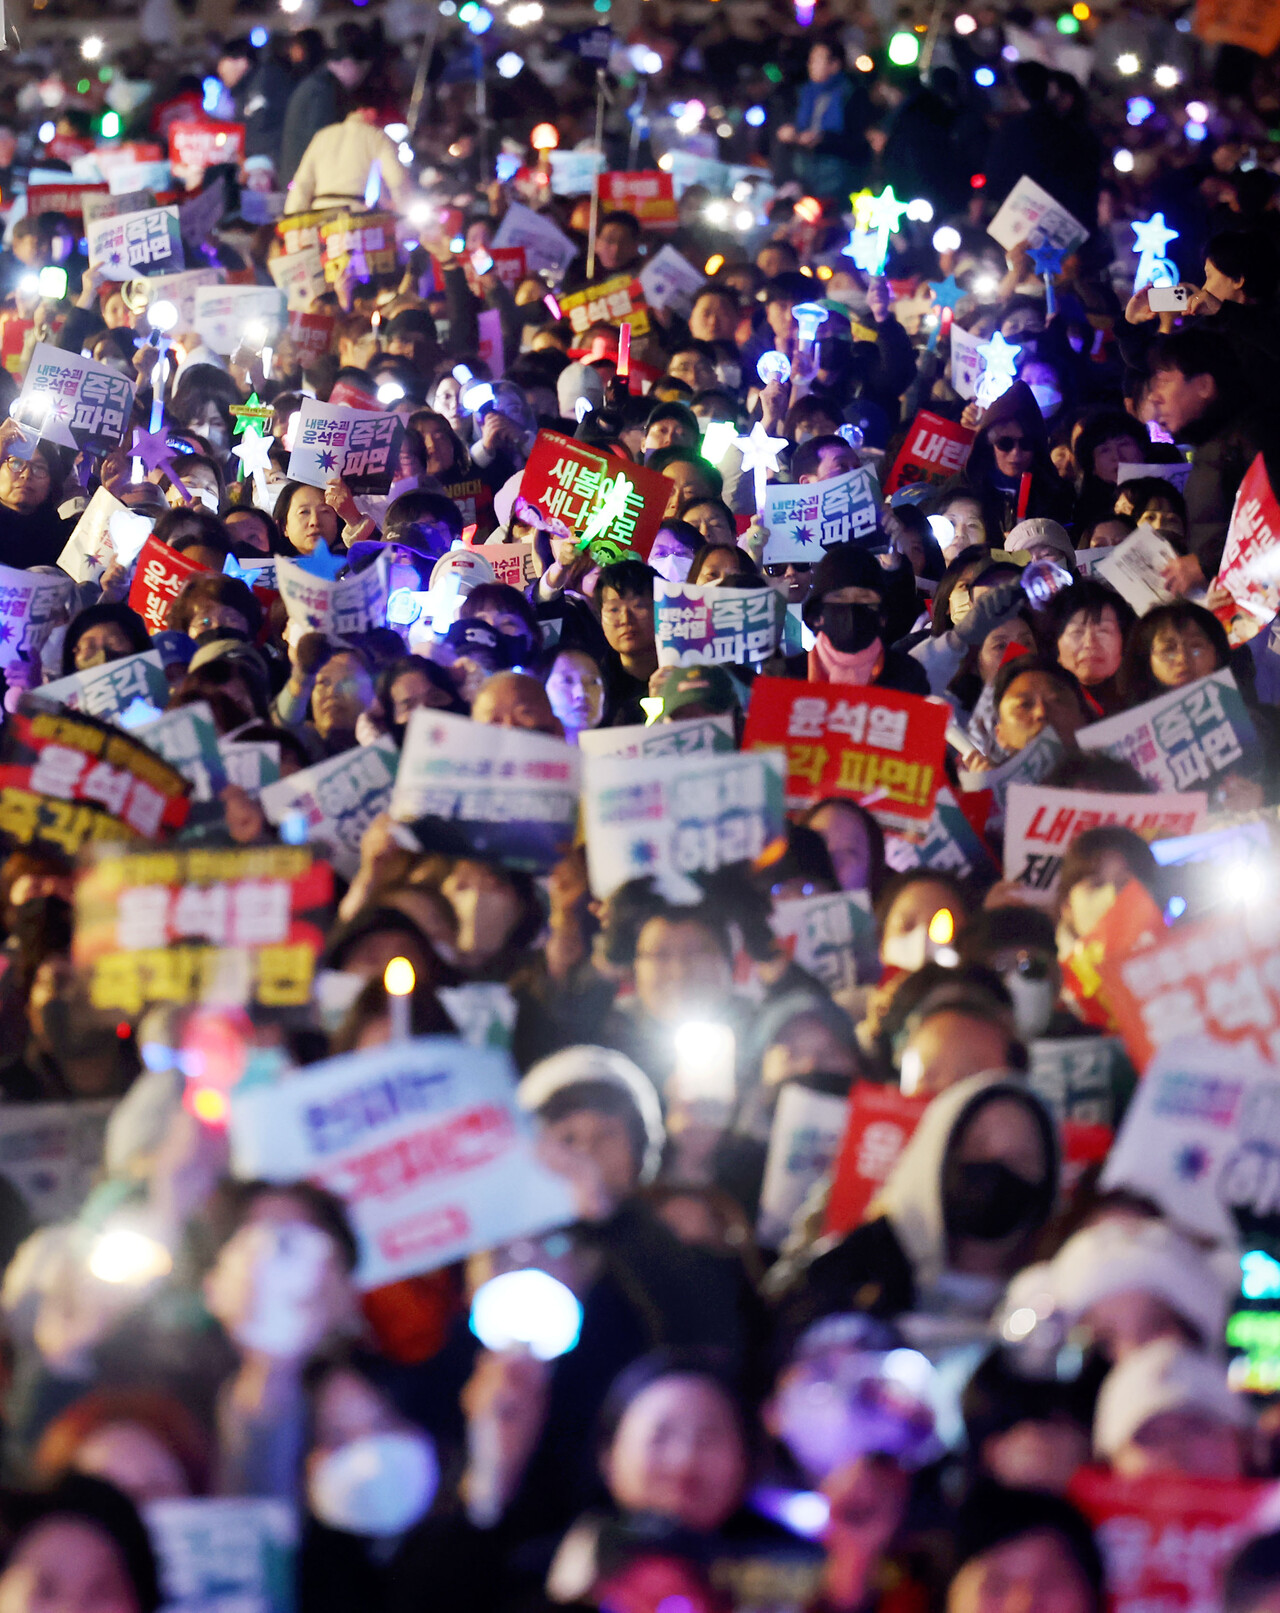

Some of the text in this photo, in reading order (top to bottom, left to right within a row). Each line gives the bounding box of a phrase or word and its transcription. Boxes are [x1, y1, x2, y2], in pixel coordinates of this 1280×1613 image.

[127, 211, 168, 243] 즉각
[128, 234, 172, 266] 파면
[32, 376, 79, 397] 윤석열
[37, 363, 83, 380] 내란수괴
[81, 371, 130, 409] 즉각
[71, 403, 124, 438] 파면
[304, 417, 350, 432] 내란수괴
[350, 416, 399, 448] 즉각
[302, 429, 347, 447] 윤석열
[342, 446, 390, 477] 파면
[771, 494, 819, 511] 내란수괴
[823, 469, 873, 517] 즉각
[772, 506, 819, 525] 윤석열
[821, 506, 877, 545] 파면
[143, 559, 190, 598] 윤석
[491, 556, 520, 571] 란수괴
[712, 592, 776, 630] 즉각
[658, 620, 707, 641] 윤석열
[712, 626, 776, 665] 파면
[83, 660, 149, 716] 즉각
[787, 697, 909, 752] 윤석열
[1158, 682, 1226, 748] 즉각
[1168, 720, 1243, 790] 파면
[836, 749, 934, 807] 파면!
